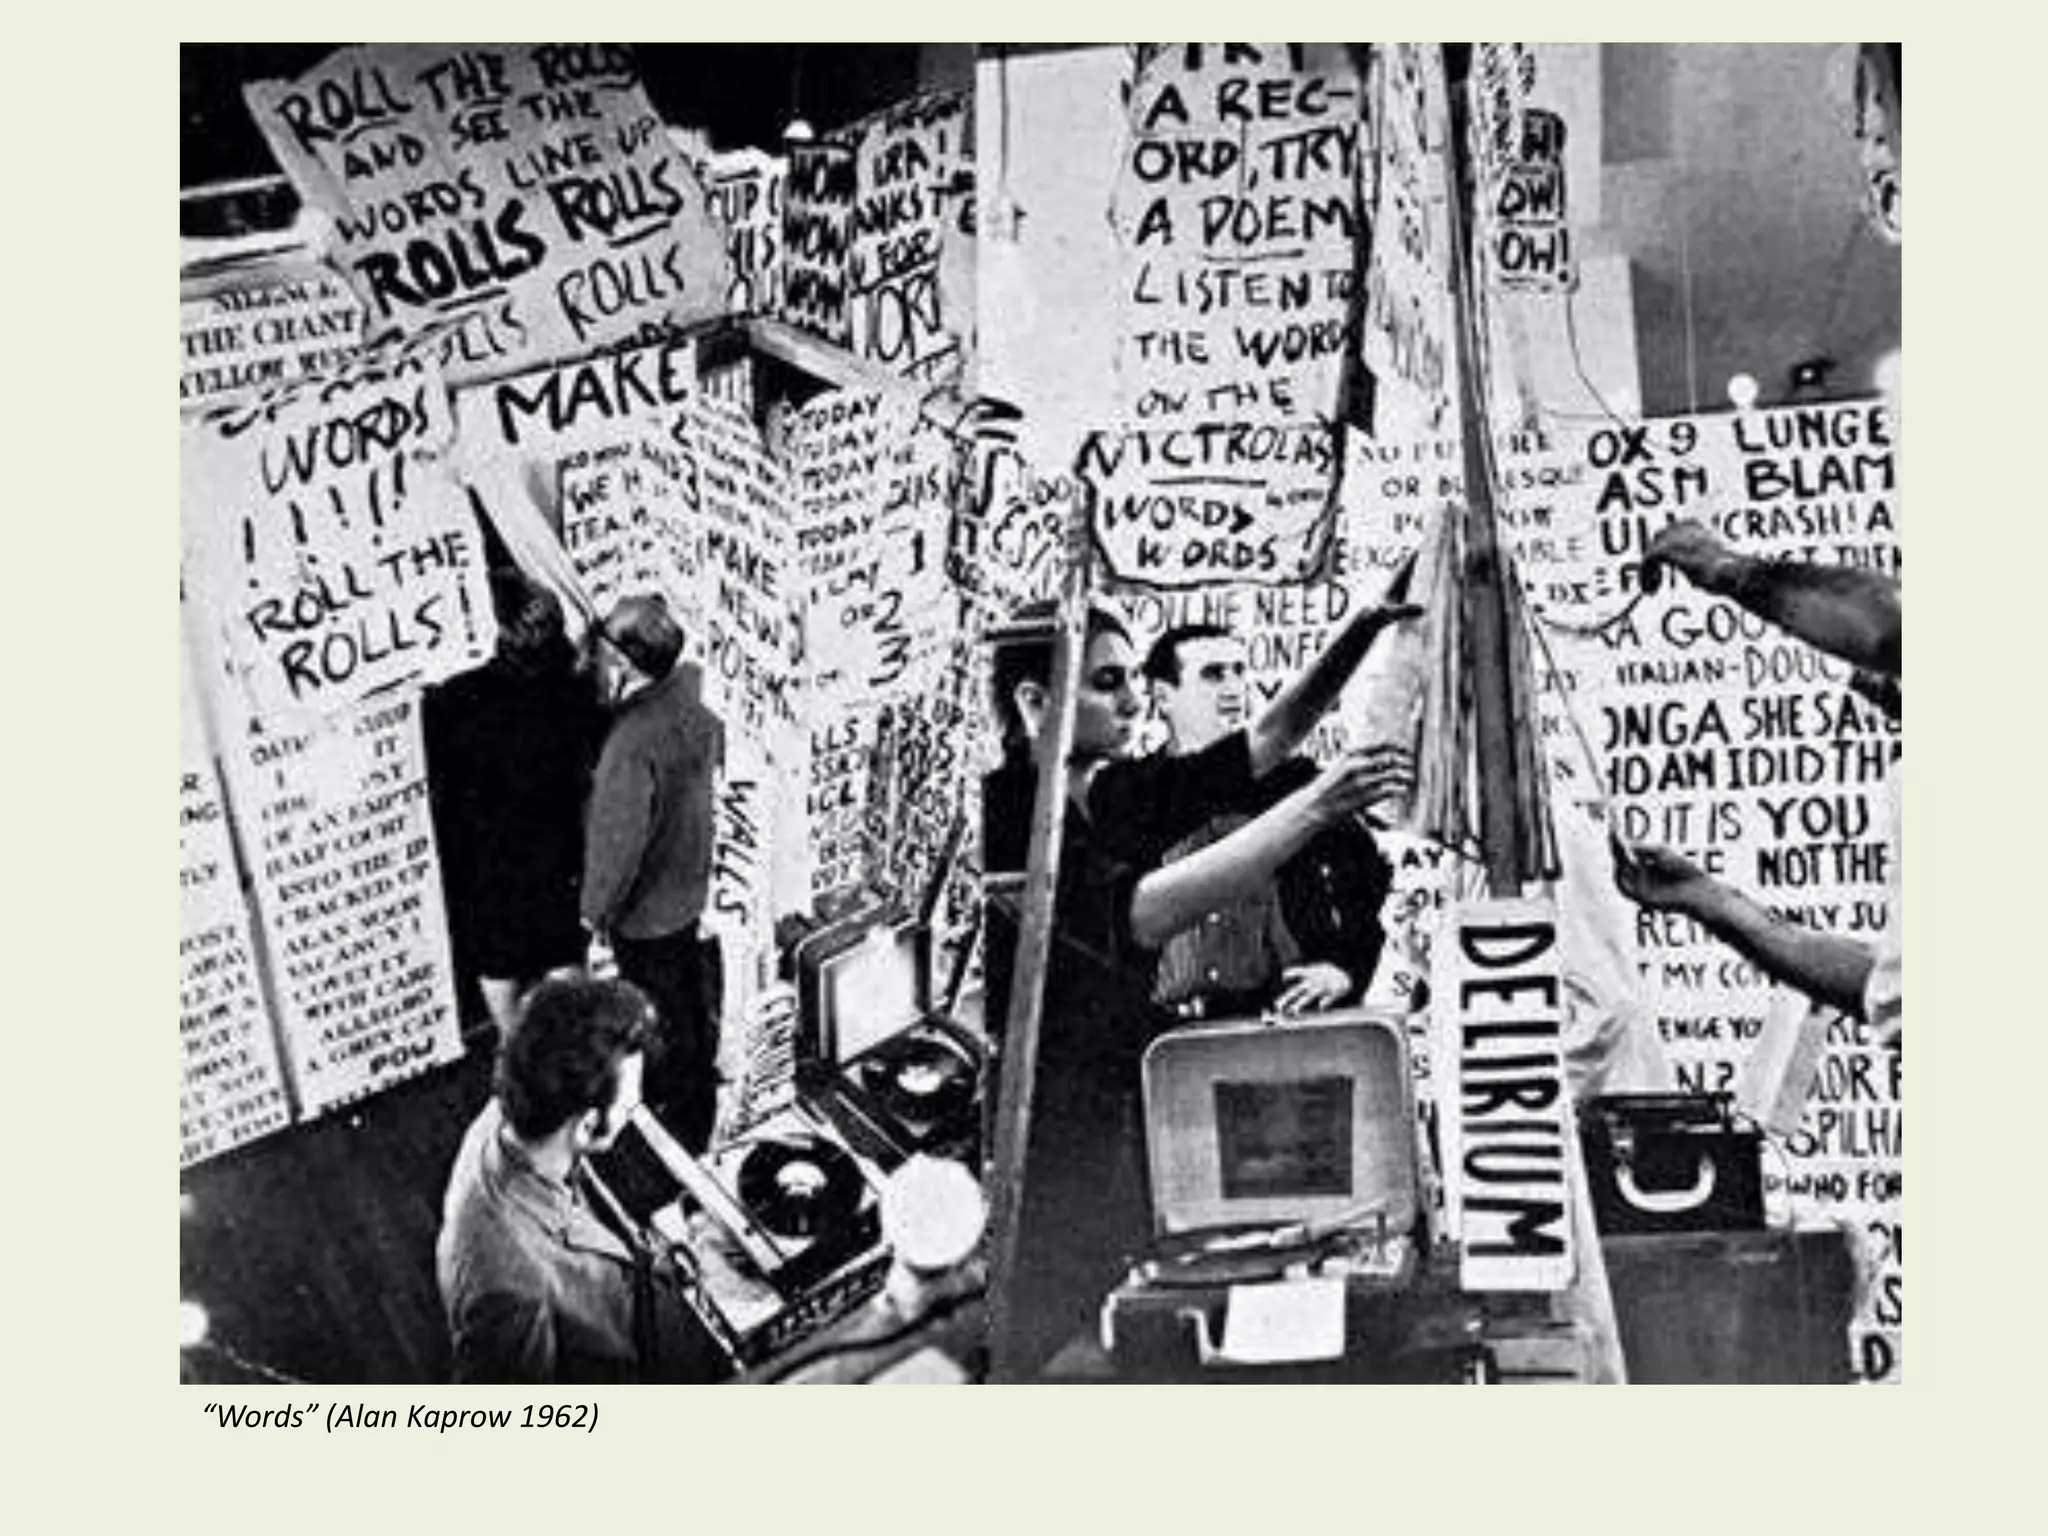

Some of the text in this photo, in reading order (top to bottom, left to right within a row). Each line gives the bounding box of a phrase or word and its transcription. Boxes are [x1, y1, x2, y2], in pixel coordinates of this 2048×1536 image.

[276, 66, 413, 155] ROLL
[415, 51, 511, 111] THE
[1145, 77, 1354, 131] A REC-
[342, 133, 427, 181] AND
[518, 90, 602, 122] THE
[1256, 121, 1358, 181] TRY
[335, 117, 657, 243] WORDS LINE UP
[353, 200, 548, 317] ROLLS
[546, 158, 685, 241] ROLLS
[1135, 193, 1357, 247] A POEM
[1500, 227, 1569, 284] OH!
[556, 242, 685, 342] ROLLS
[1133, 261, 1312, 315] LISTEN
[1133, 330, 1209, 365] THE
[496, 336, 689, 444] MAKE
[801, 393, 884, 433] TODAY
[1207, 376, 1295, 413] THE
[262, 384, 428, 496] WORDS
[1587, 406, 1891, 469] OX 9 LUNGE
[802, 453, 880, 493] TODAY
[1381, 475, 1420, 498] OR
[1744, 452, 1895, 502] BLAM
[796, 515, 875, 552] TODAY
[1867, 501, 1893, 532] A
[246, 529, 467, 643] ROLL THE
[873, 590, 904, 634] 2
[1743, 693, 1804, 740] SHE
[1657, 750, 1717, 791] AM
[1756, 794, 1870, 843] YOU
[1661, 960, 1708, 989] MY
[368, 1035, 436, 1076] POW
[1458, 921, 1566, 1257] DELIRIUM
